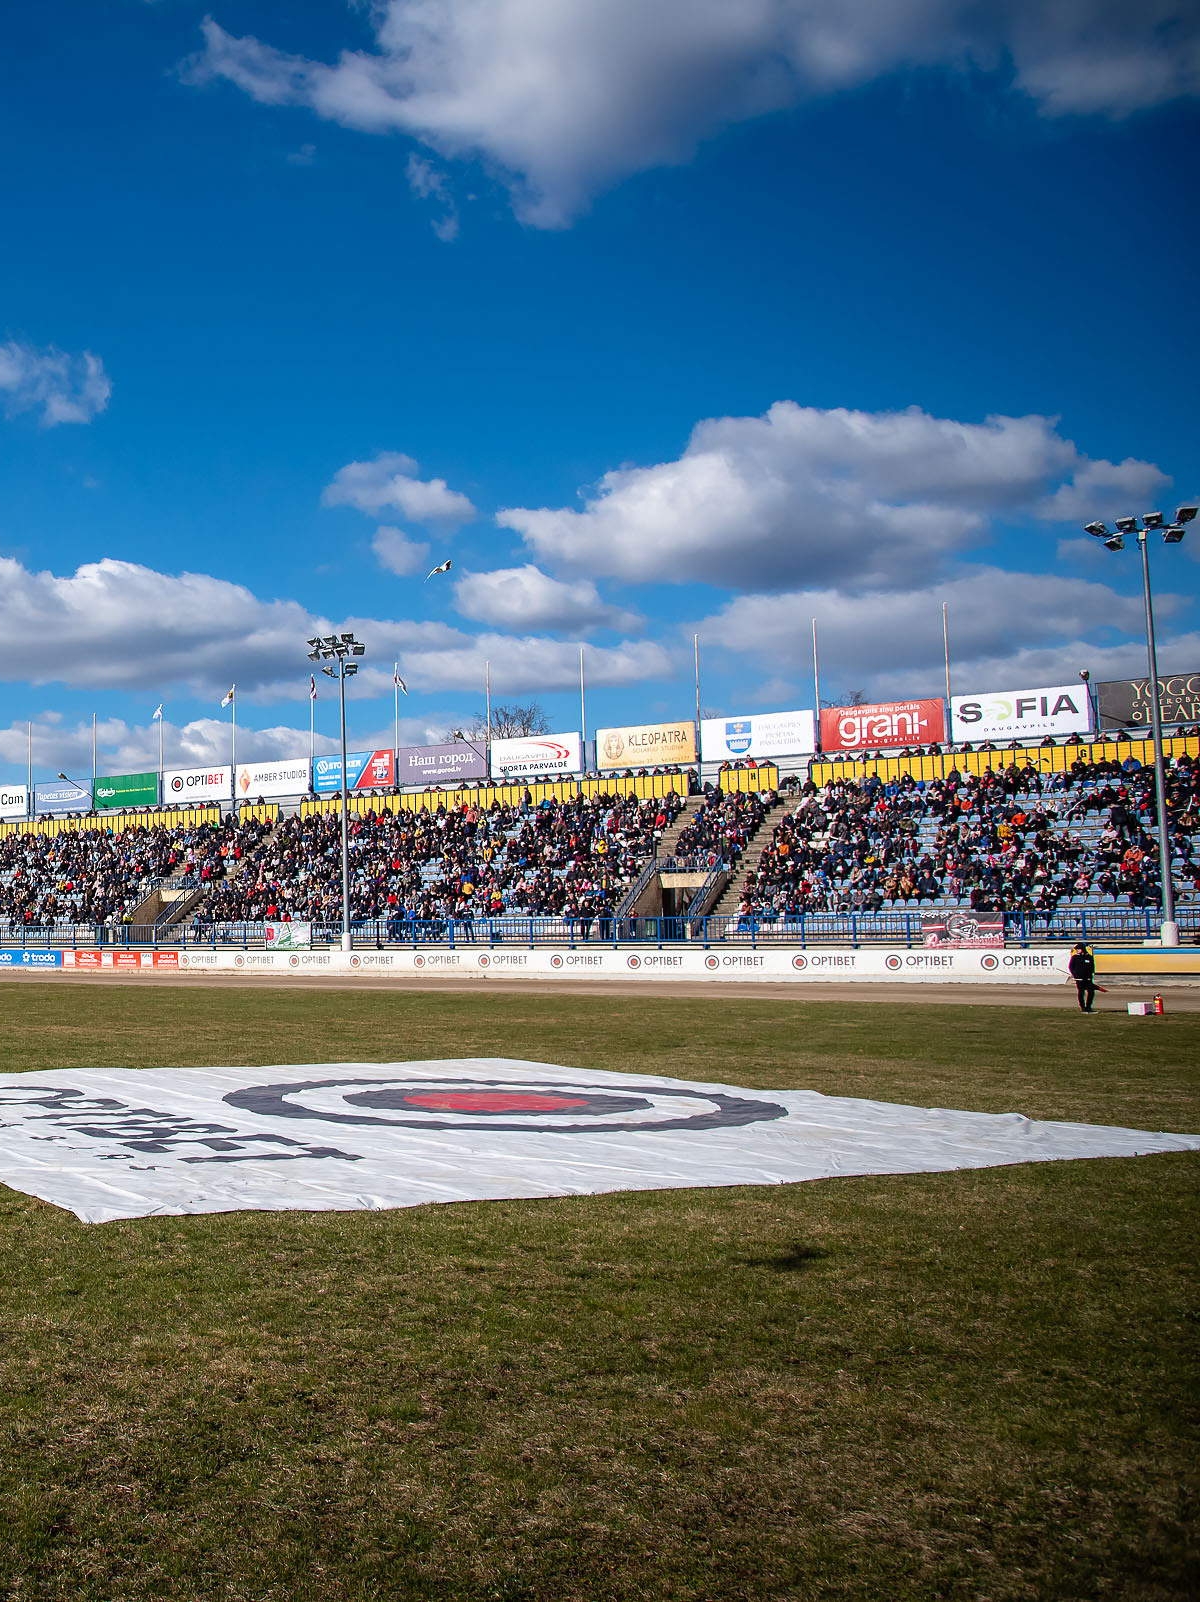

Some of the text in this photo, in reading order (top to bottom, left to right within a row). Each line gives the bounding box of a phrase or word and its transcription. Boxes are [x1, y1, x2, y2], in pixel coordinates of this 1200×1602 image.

[1132, 695, 1200, 708] GATROBA
[840, 706, 878, 717] Daugavpils
[839, 712, 919, 747] grani
[983, 722, 1055, 732] DAUGAVPILS
[628, 730, 688, 746] KLEOPATRA
[1080, 749, 1087, 758] G
[328, 759, 362, 770] STOKER
[408, 755, 436, 767] Наш
[422, 766, 462, 775] www.gorod.lv
[499, 763, 528, 773] SPORTA
[186, 773, 224, 787] OPTIBET
[253, 772, 278, 782] AMBER
[279, 769, 307, 781] STUDIOS
[30, 952, 56, 962] trodo
[191, 955, 218, 964] OPTIBET
[246, 956, 275, 964] OPTIBET
[302, 956, 331, 965] OPTIBET
[362, 956, 394, 965] OPTIBET
[427, 956, 461, 965] OPTIBET
[492, 955, 528, 965] OPTIBET
[566, 956, 604, 966] OPTIBET
[643, 956, 684, 966] OPTIBET
[722, 956, 765, 966] OPTIBET
[811, 956, 856, 966] OPTIBET
[905, 955, 955, 967] OPTIBET
[1002, 955, 1055, 967] OPTIBET
